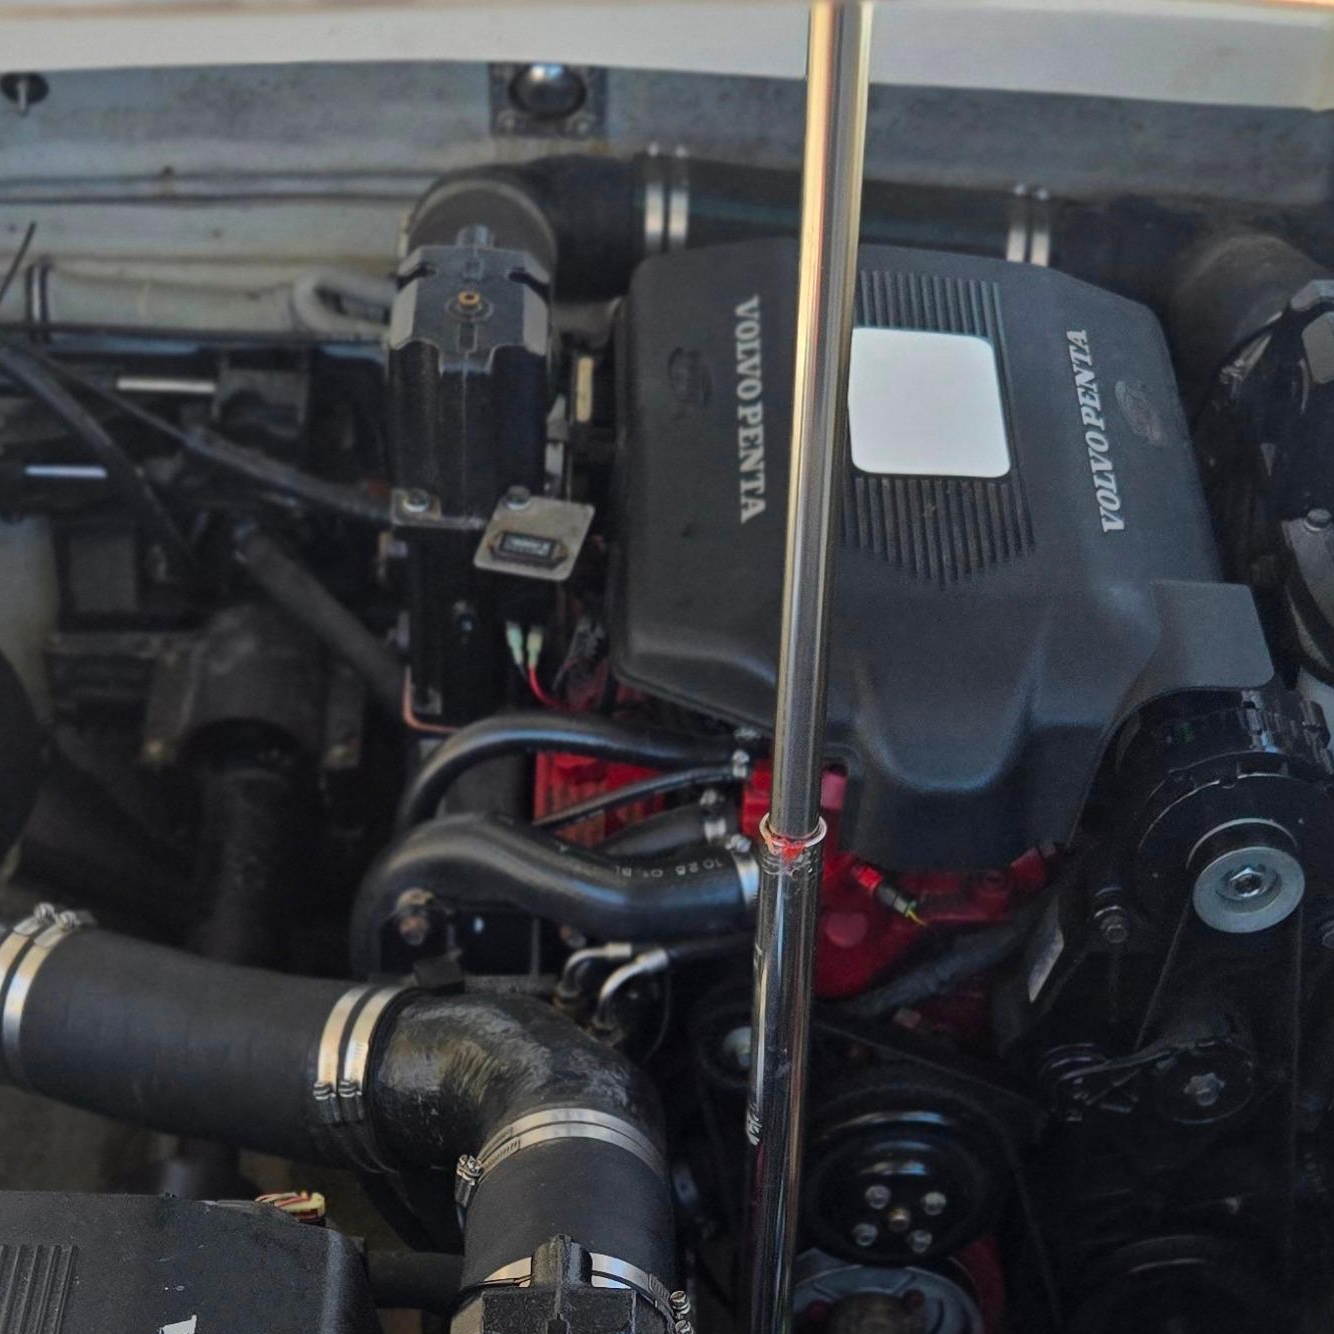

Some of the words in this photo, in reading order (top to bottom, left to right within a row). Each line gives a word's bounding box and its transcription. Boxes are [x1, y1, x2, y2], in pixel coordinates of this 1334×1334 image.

[734, 295, 764, 402] VOLVO
[1066, 329, 1104, 432] PENTA
[737, 404, 767, 524] PENTA
[1085, 431, 1125, 534] VOLVO
